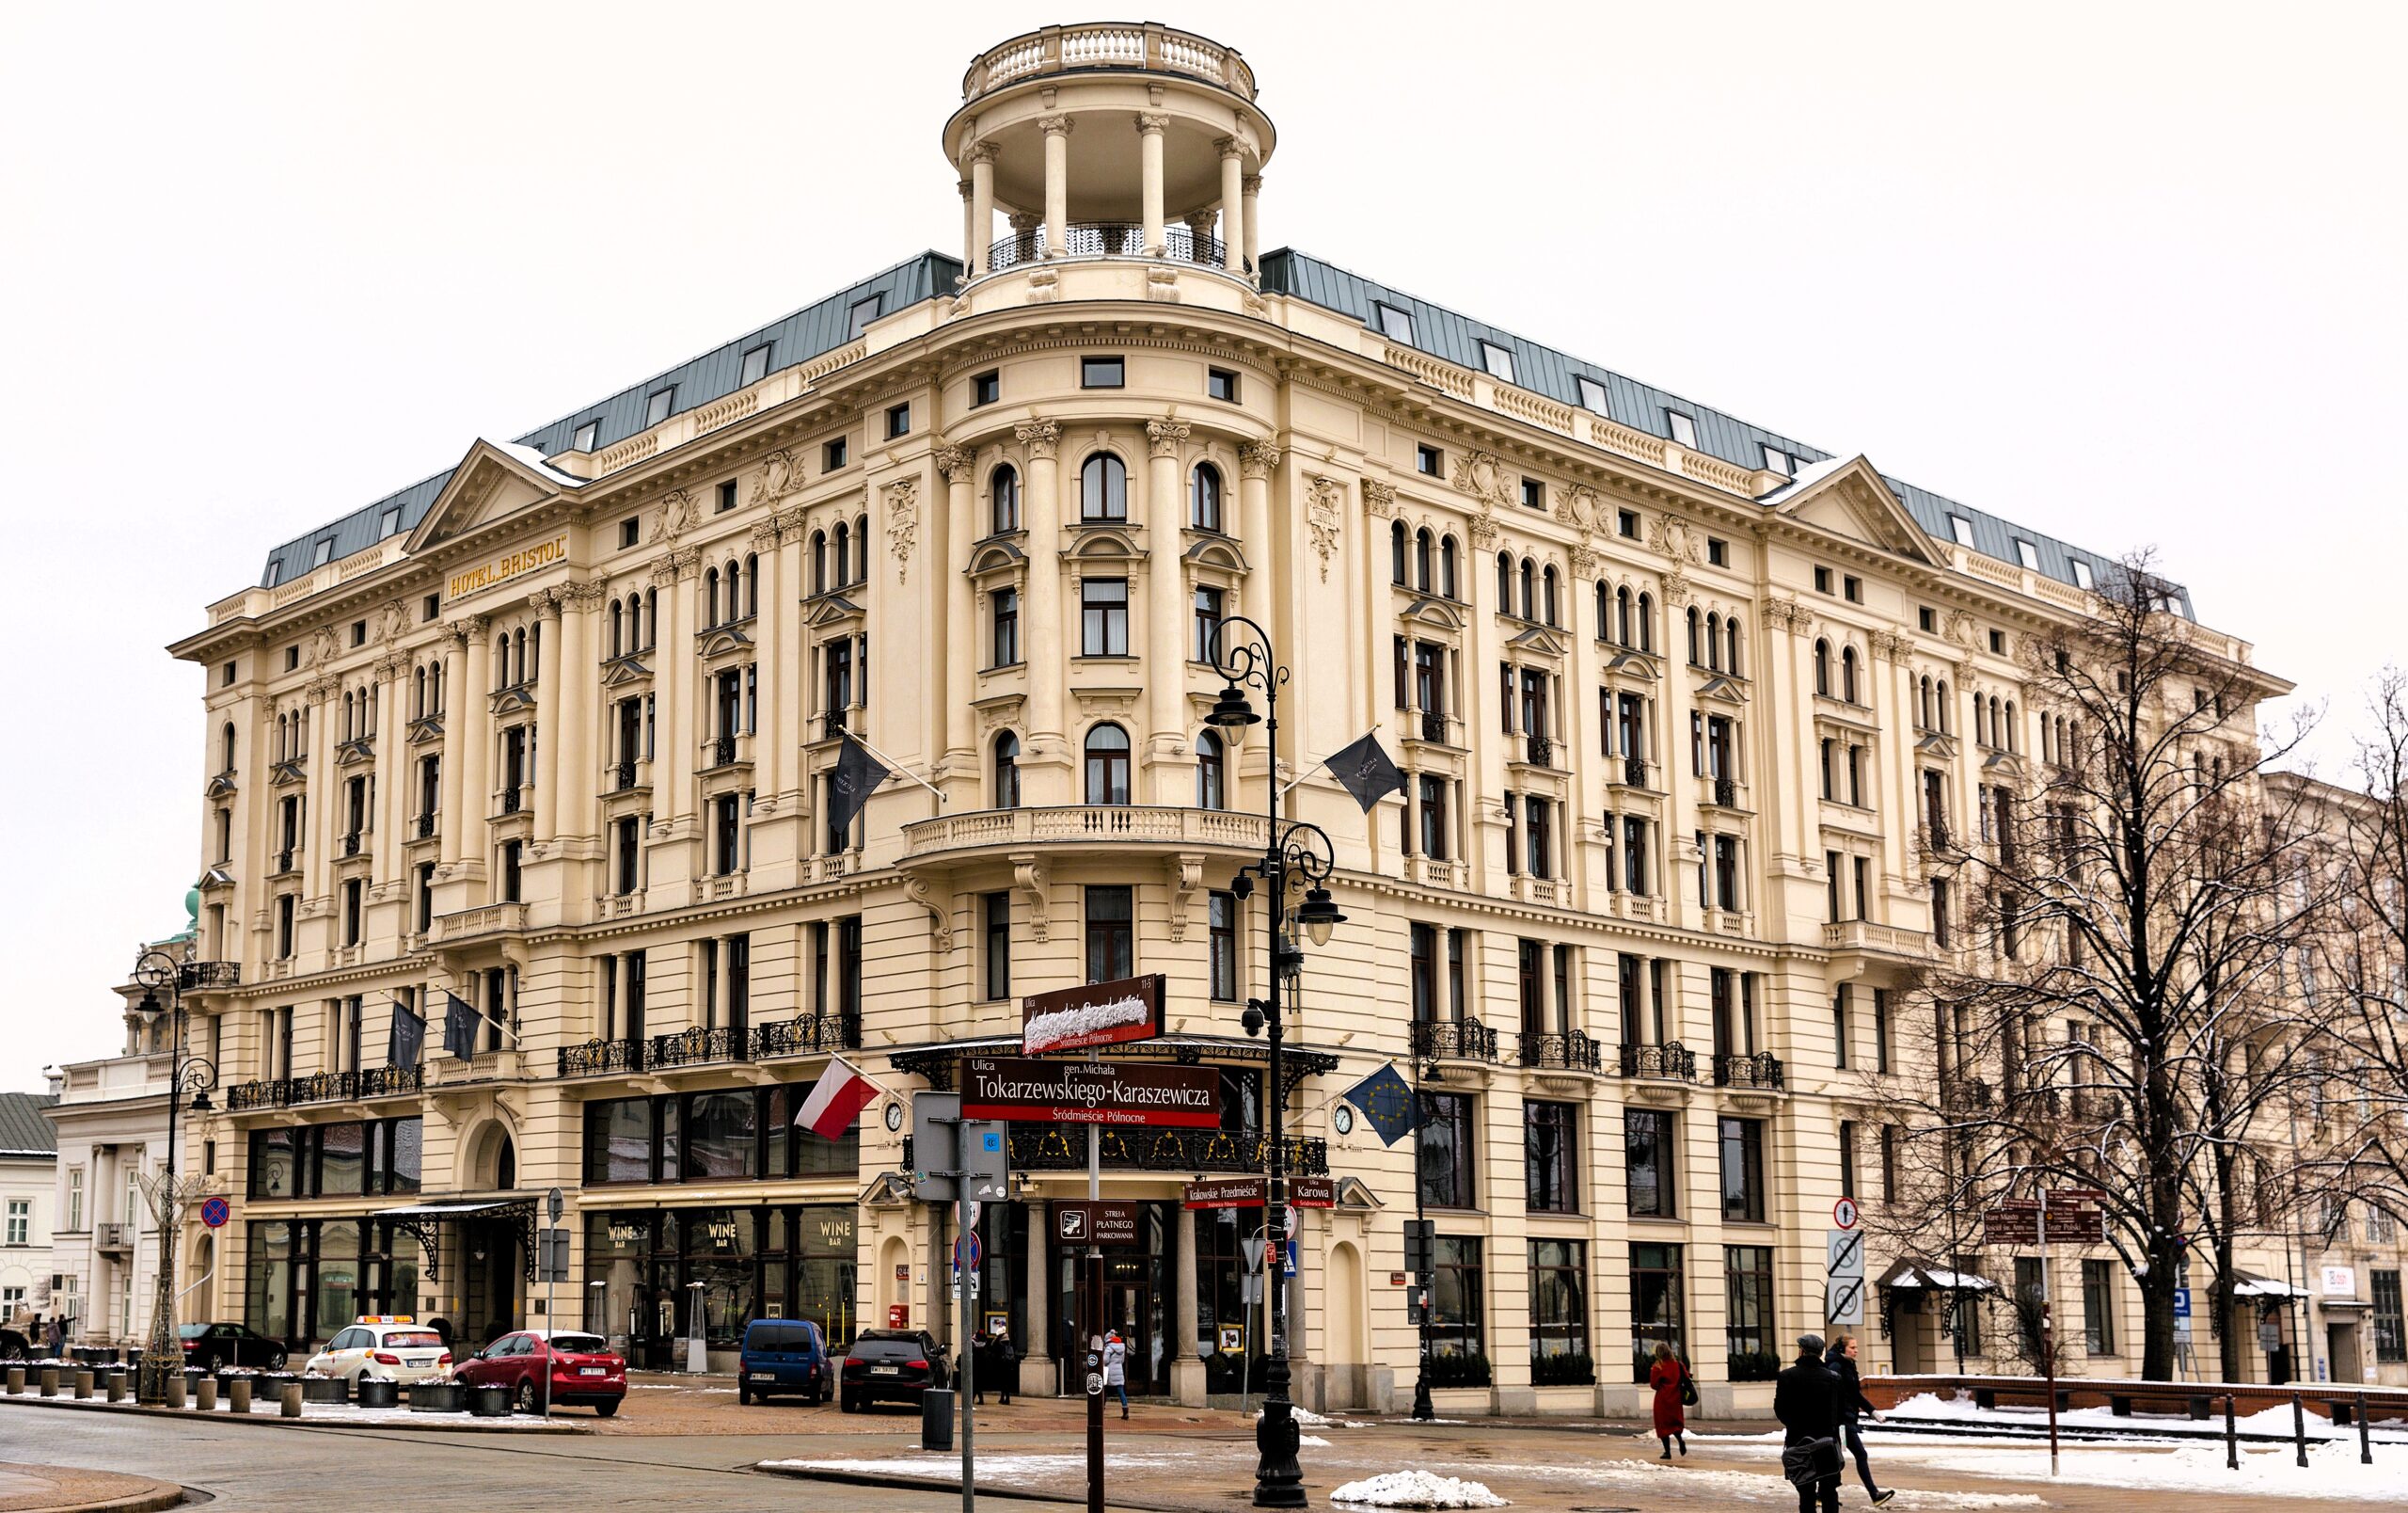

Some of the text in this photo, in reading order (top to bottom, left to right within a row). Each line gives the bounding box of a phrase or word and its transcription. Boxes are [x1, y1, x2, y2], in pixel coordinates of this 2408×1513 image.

[451, 564, 496, 597] HOTEL
[1025, 999, 1036, 1008] Ulica
[1088, 1033, 1113, 1043] Północne
[972, 1059, 995, 1071] Ulica
[976, 1074, 1211, 1108] Tokarzewskiego-Karaszewicza
[1053, 1107, 1146, 1123] Śródmieście Północne
[1189, 1185, 1258, 1201] Krakowskie Przedmieście
[1298, 1186, 1329, 1198] Karowa
[708, 1223, 737, 1238] WINE
[820, 1221, 850, 1236] WINE
[1096, 1220, 1133, 1229] PŁATNEGO
[608, 1226, 633, 1239] WINE
[716, 1239, 728, 1248] BAR
